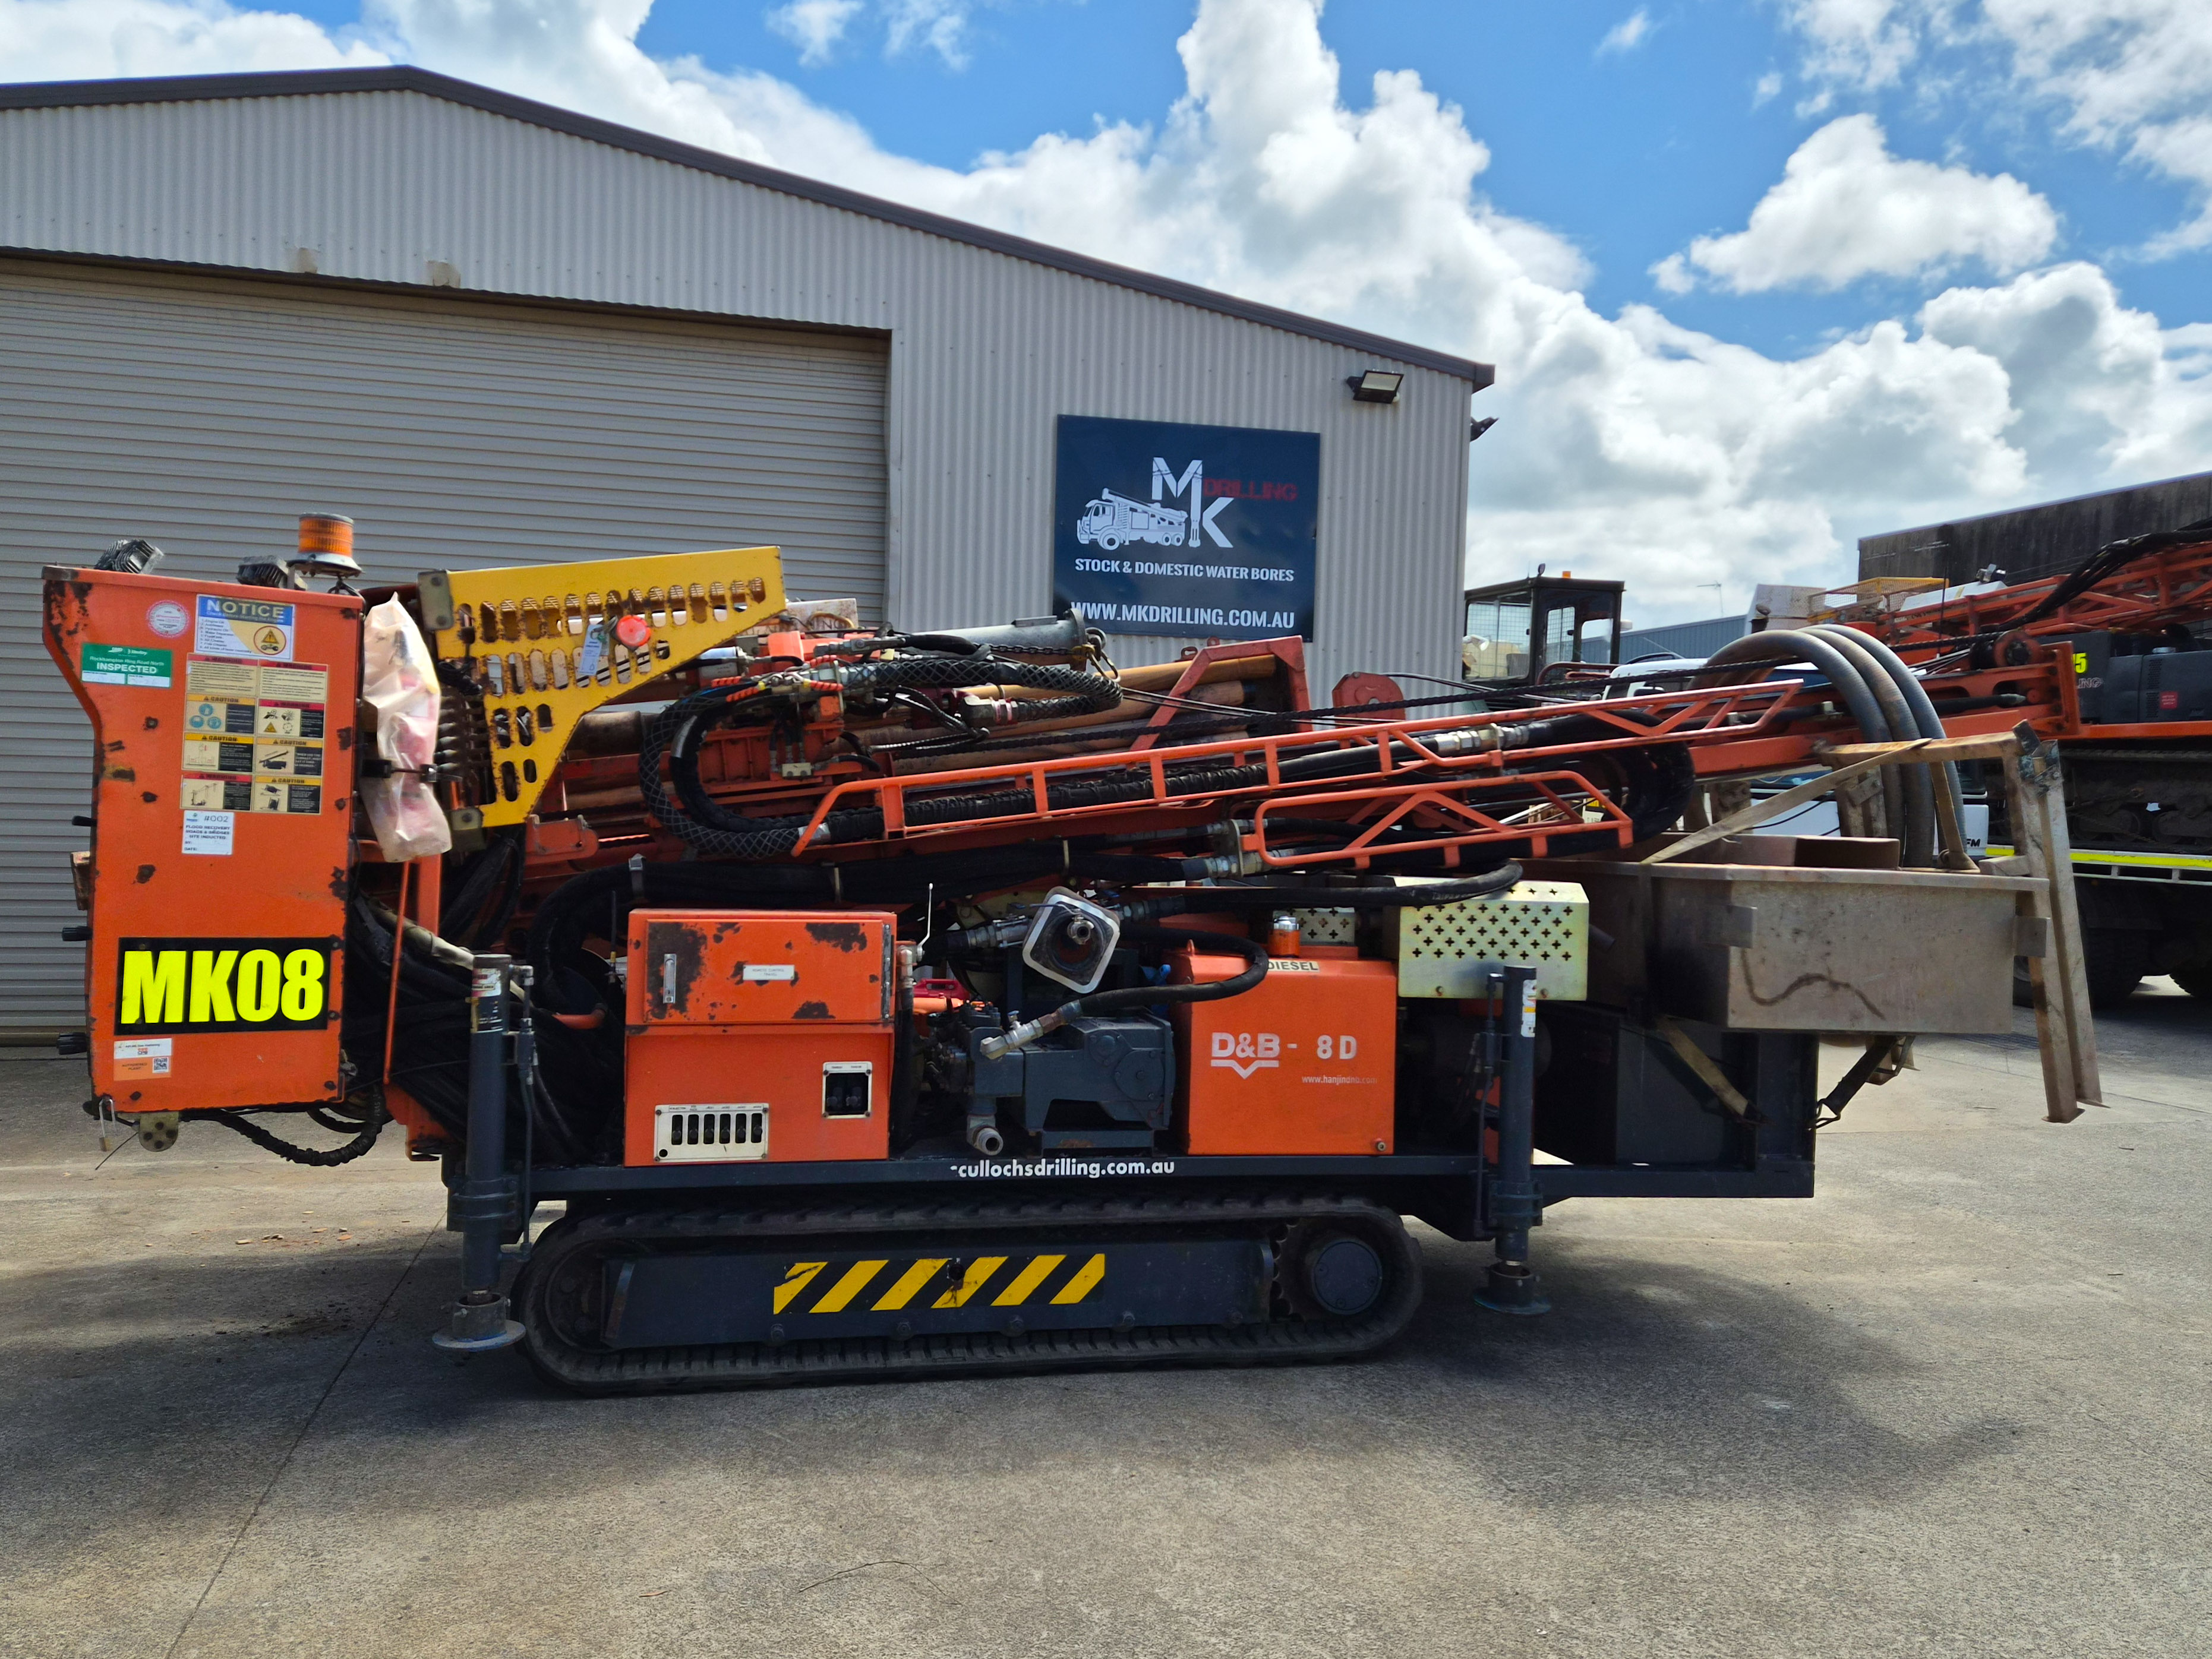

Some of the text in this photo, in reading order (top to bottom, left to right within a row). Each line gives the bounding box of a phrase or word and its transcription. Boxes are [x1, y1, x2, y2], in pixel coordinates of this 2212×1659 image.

[1203, 478, 1298, 502] DRILLING
[1075, 558, 1295, 582] STOCK & DOMESTIC WATER BORES
[207, 599, 284, 618] NOTICE
[97, 662, 157, 674] INSPECTED
[2072, 653, 2086, 673] 5
[1268, 961, 1319, 971] DIESEL
[121, 949, 324, 1024] MK08
[1211, 1032, 1280, 1058] D&B
[950, 1158, 1175, 1178] cullochsdrilling.com.au
